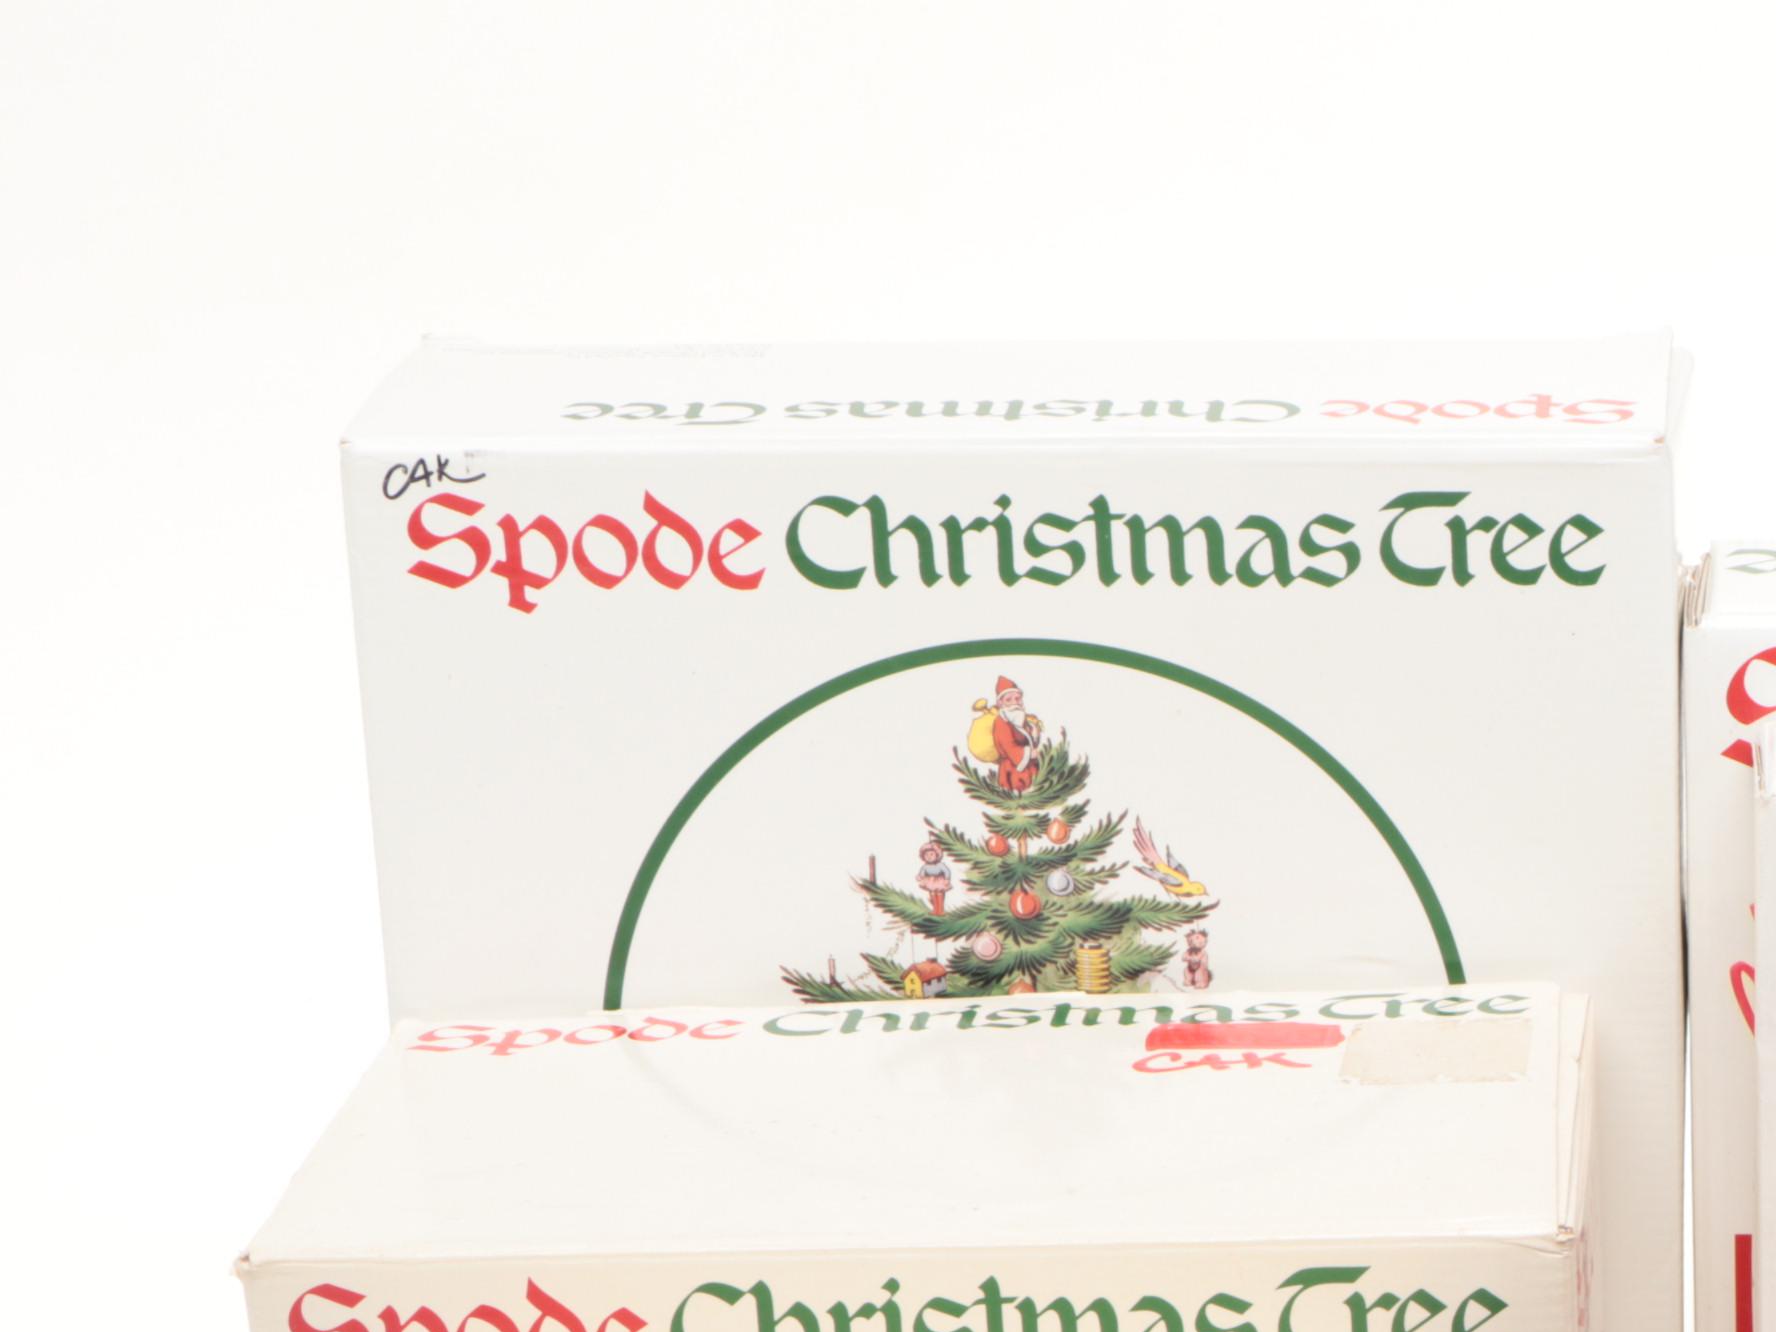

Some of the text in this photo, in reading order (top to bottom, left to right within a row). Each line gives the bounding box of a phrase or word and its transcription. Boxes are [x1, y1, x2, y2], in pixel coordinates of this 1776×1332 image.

[562, 393, 1636, 426] Spode Christmas Tree
[407, 489, 1607, 615] Spode Christmas Tree
[408, 992, 1530, 1057] Spode Christmas Tree
